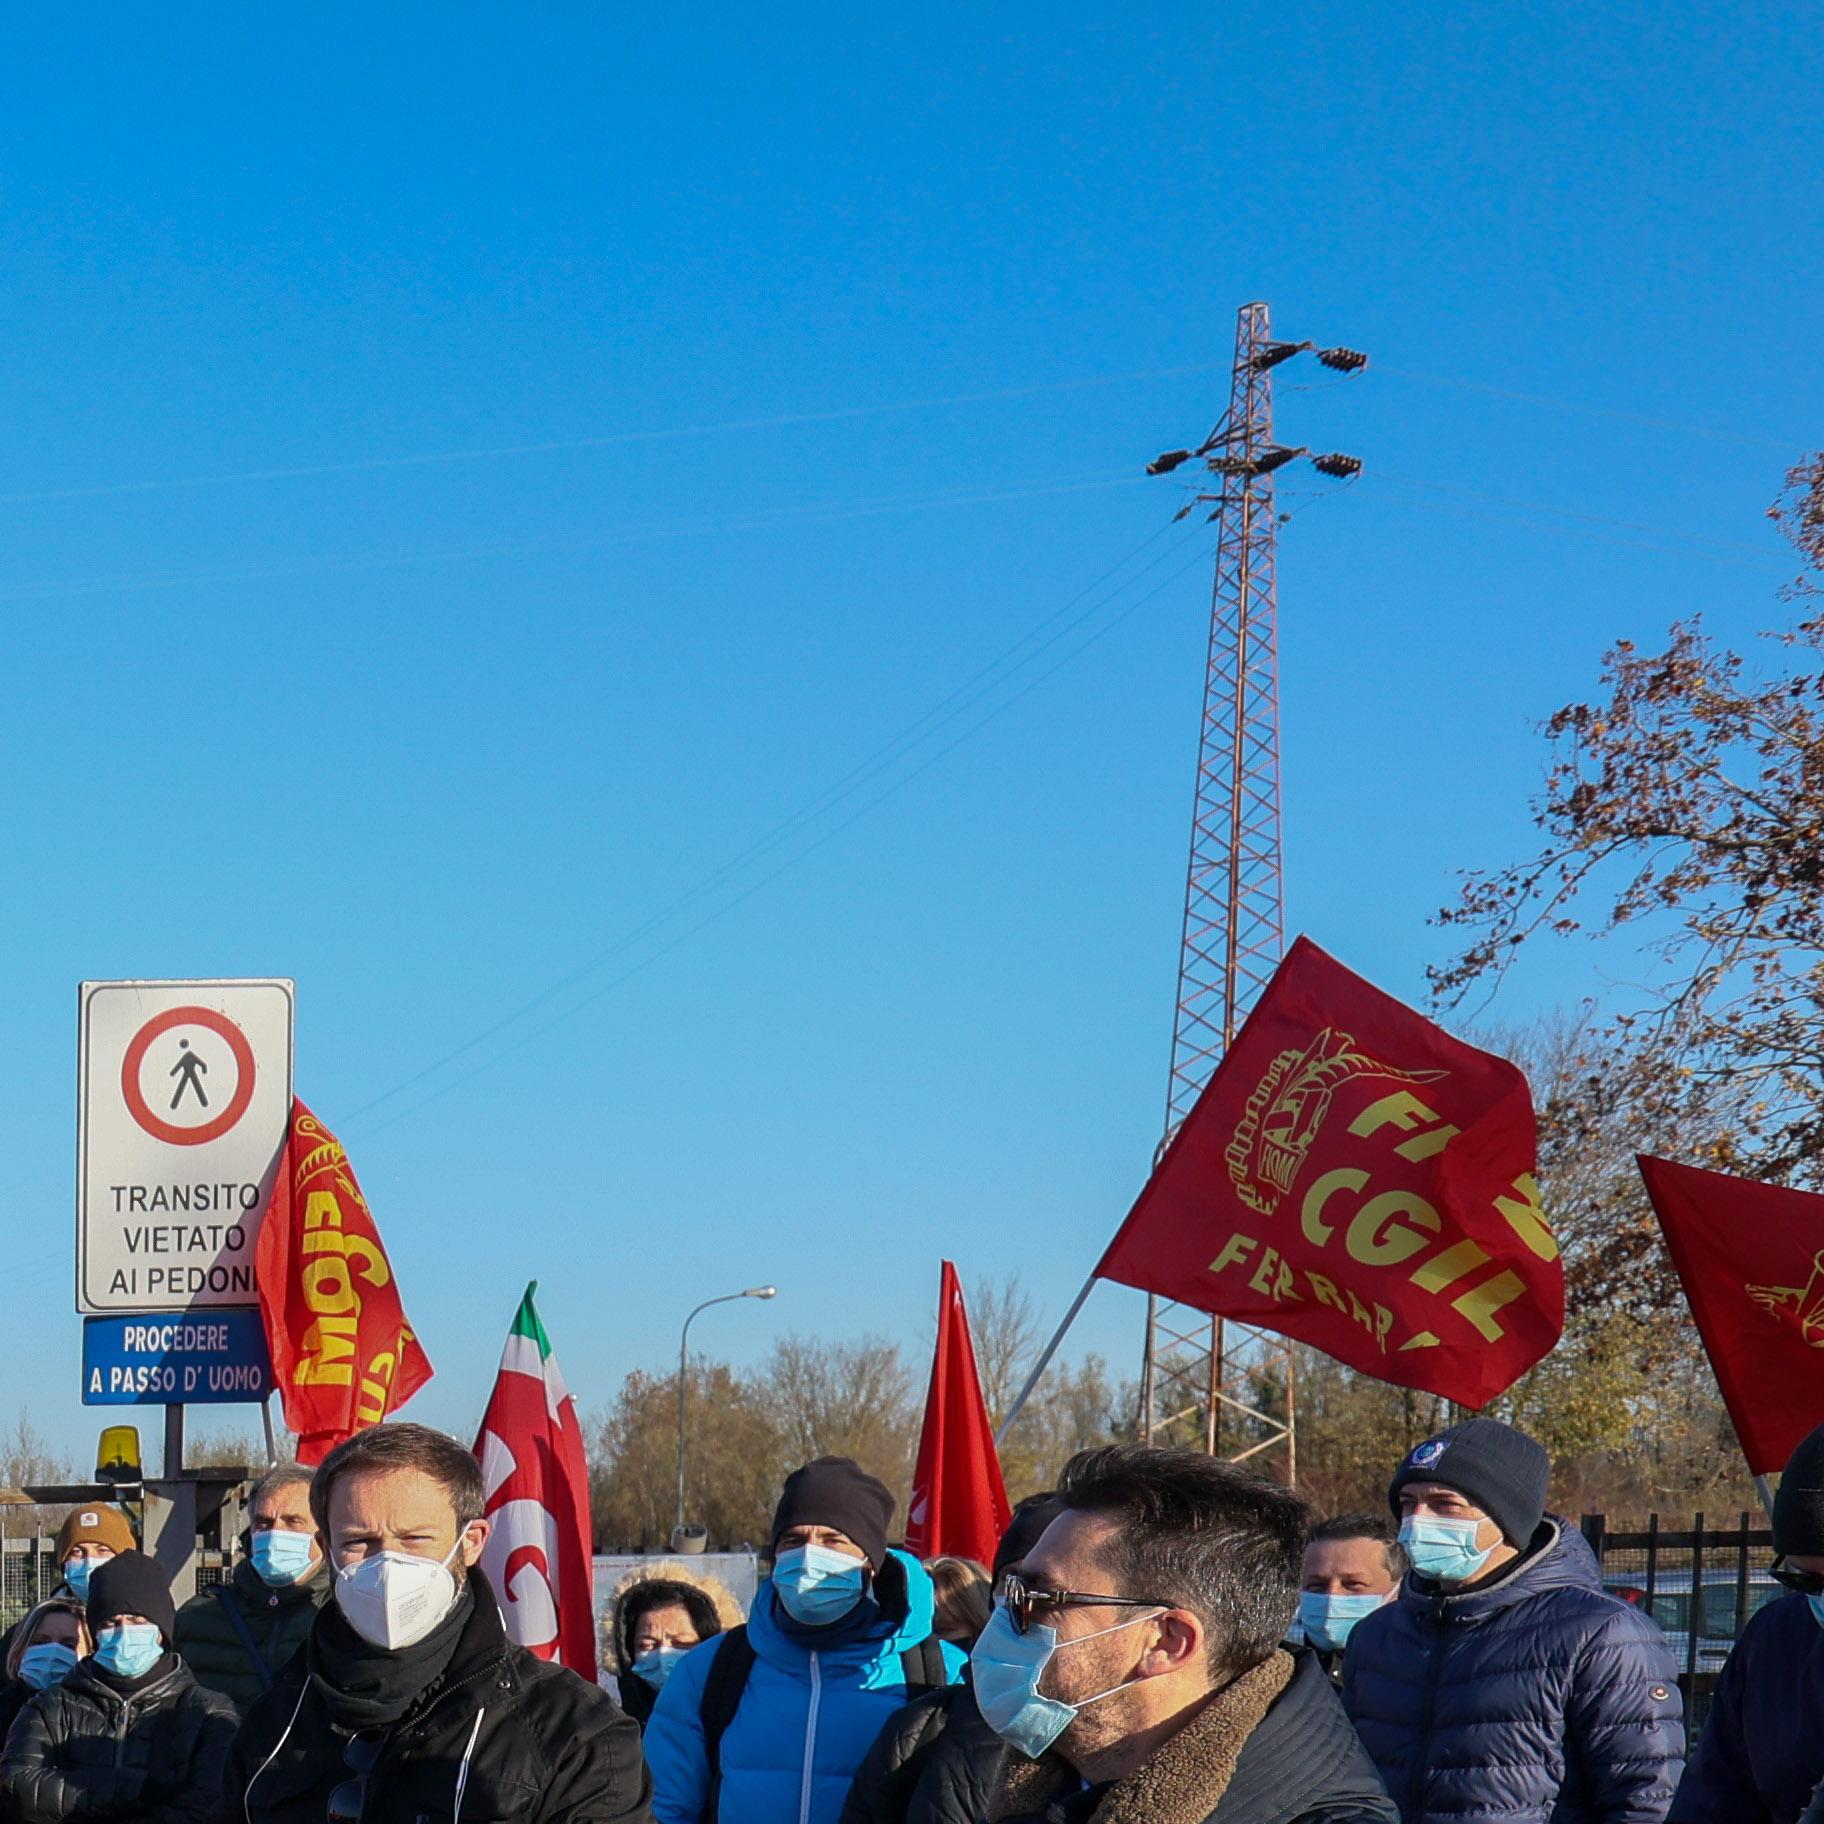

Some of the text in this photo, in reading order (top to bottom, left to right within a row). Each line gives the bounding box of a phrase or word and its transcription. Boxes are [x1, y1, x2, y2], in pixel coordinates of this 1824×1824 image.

[1261, 1144, 1297, 1188] FIOM
[110, 1183, 260, 1212] TRANSITO
[124, 1225, 245, 1253] VIETATO
[1301, 1168, 1527, 1343] CGIL
[109, 1265, 259, 1295] AI PEDONI
[124, 1325, 229, 1352] PROCEDERE
[90, 1368, 103, 1393] A
[110, 1366, 176, 1393] PASSO
[209, 1365, 262, 1391] UOMO
